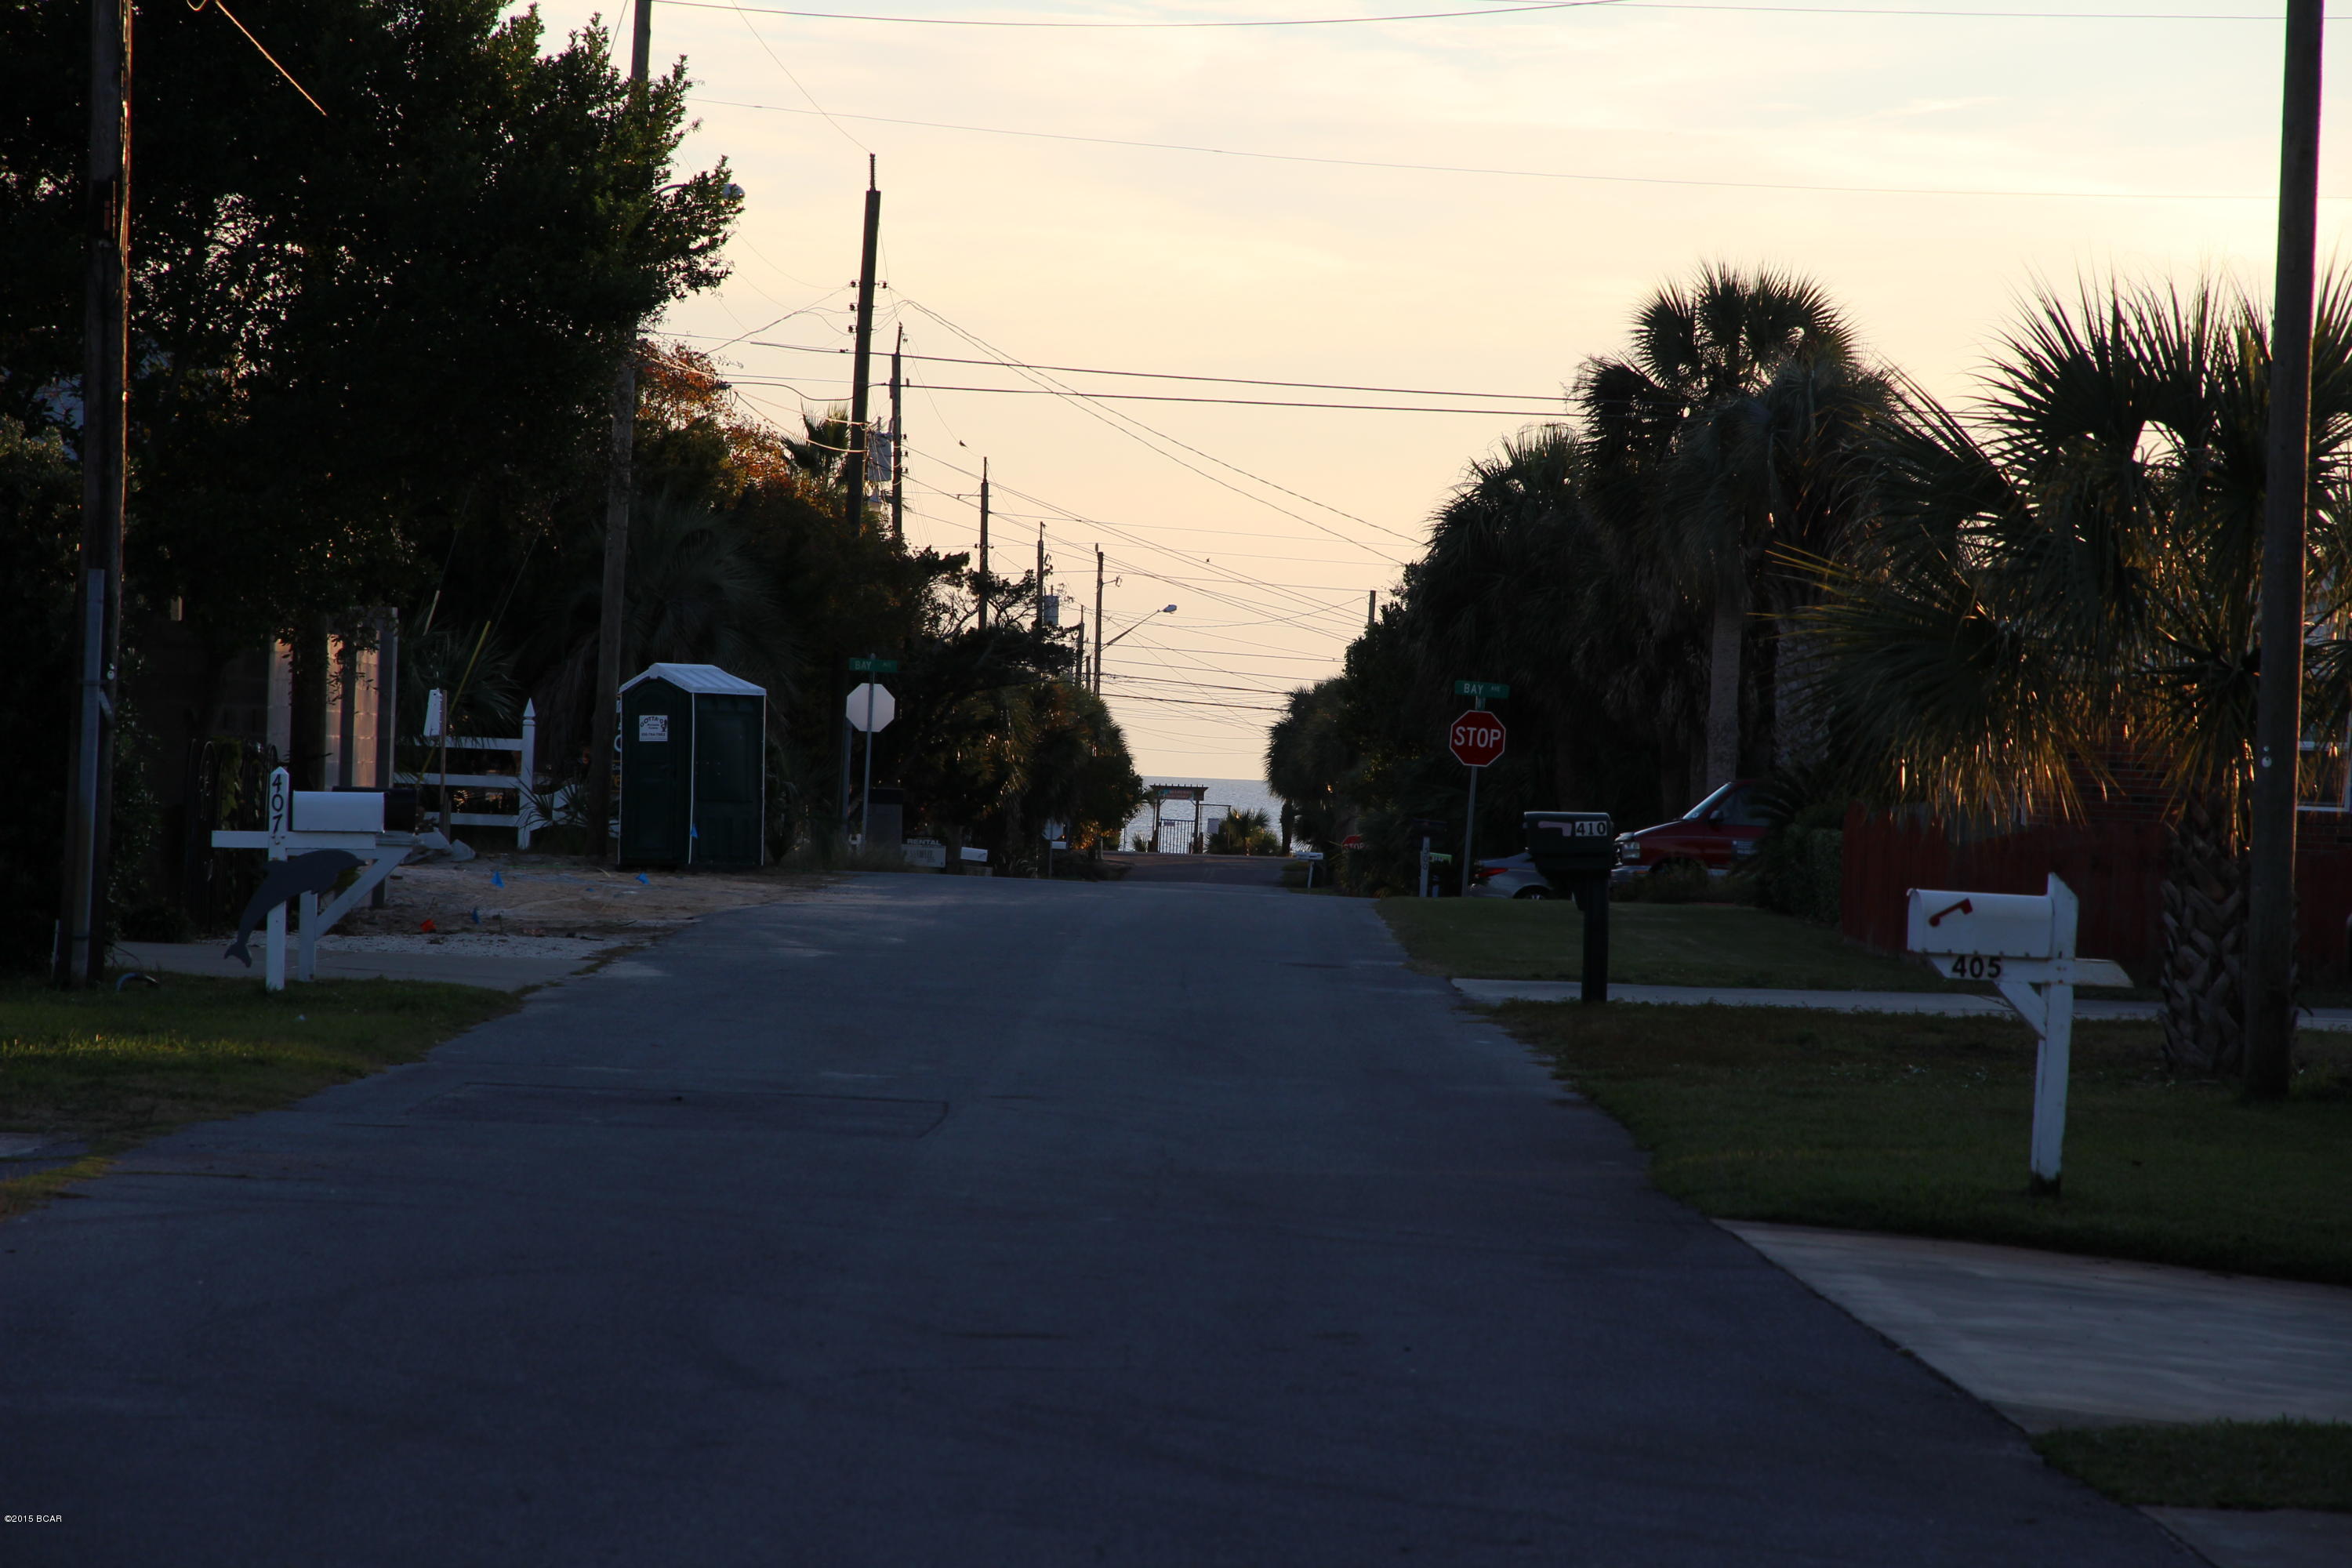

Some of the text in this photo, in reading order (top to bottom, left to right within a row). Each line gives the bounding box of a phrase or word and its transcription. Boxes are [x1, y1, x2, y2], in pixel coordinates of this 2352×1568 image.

[855, 659, 872, 670] BAY
[1463, 683, 1483, 695] BAY
[1454, 726, 1501, 749] STOP
[271, 774, 284, 833] 407
[1576, 822, 1606, 836] 410
[906, 837, 942, 846] RENTAL
[1343, 842, 1365, 851] STOP
[1951, 955, 2002, 978] 405
